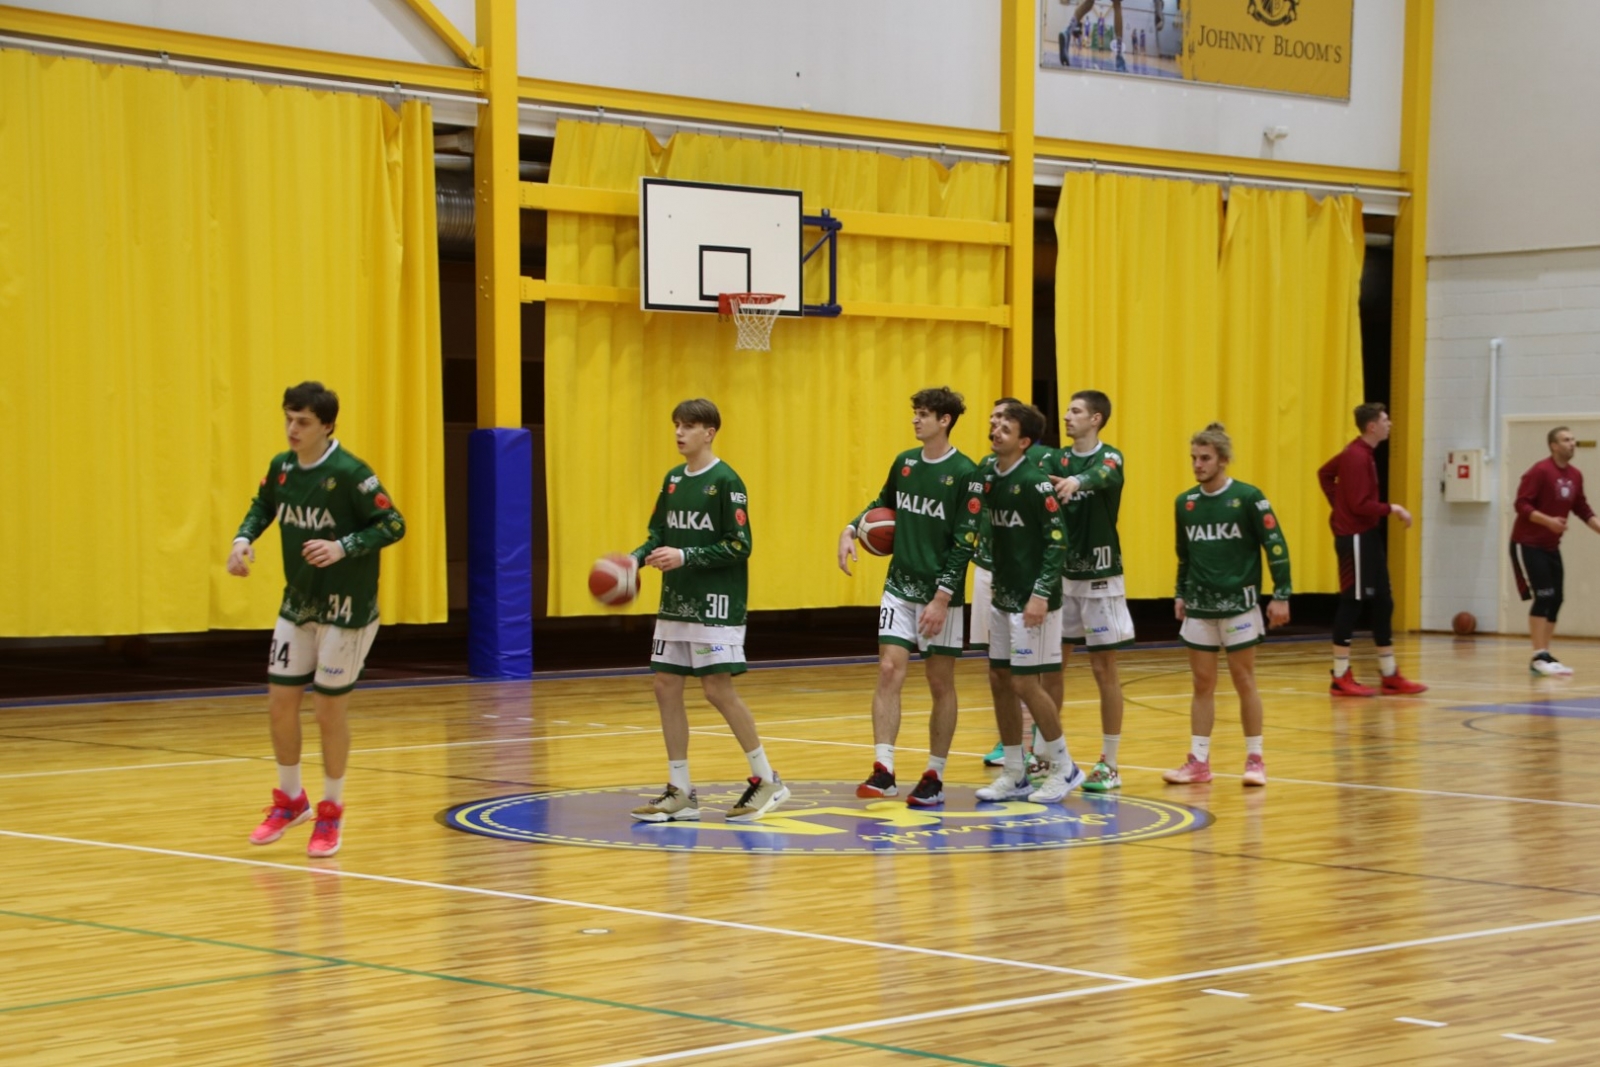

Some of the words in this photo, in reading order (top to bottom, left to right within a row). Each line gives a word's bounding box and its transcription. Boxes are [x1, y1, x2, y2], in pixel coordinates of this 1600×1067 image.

[1198, 25, 1265, 54] JOHNNY
[1273, 35, 1342, 64] BLOOM'S
[896, 490, 946, 521] VALKA
[1185, 522, 1242, 542] VALKA
[1093, 545, 1112, 571] 20
[327, 593, 353, 624] 34
[705, 593, 729, 620] 30
[879, 607, 895, 630] 31
